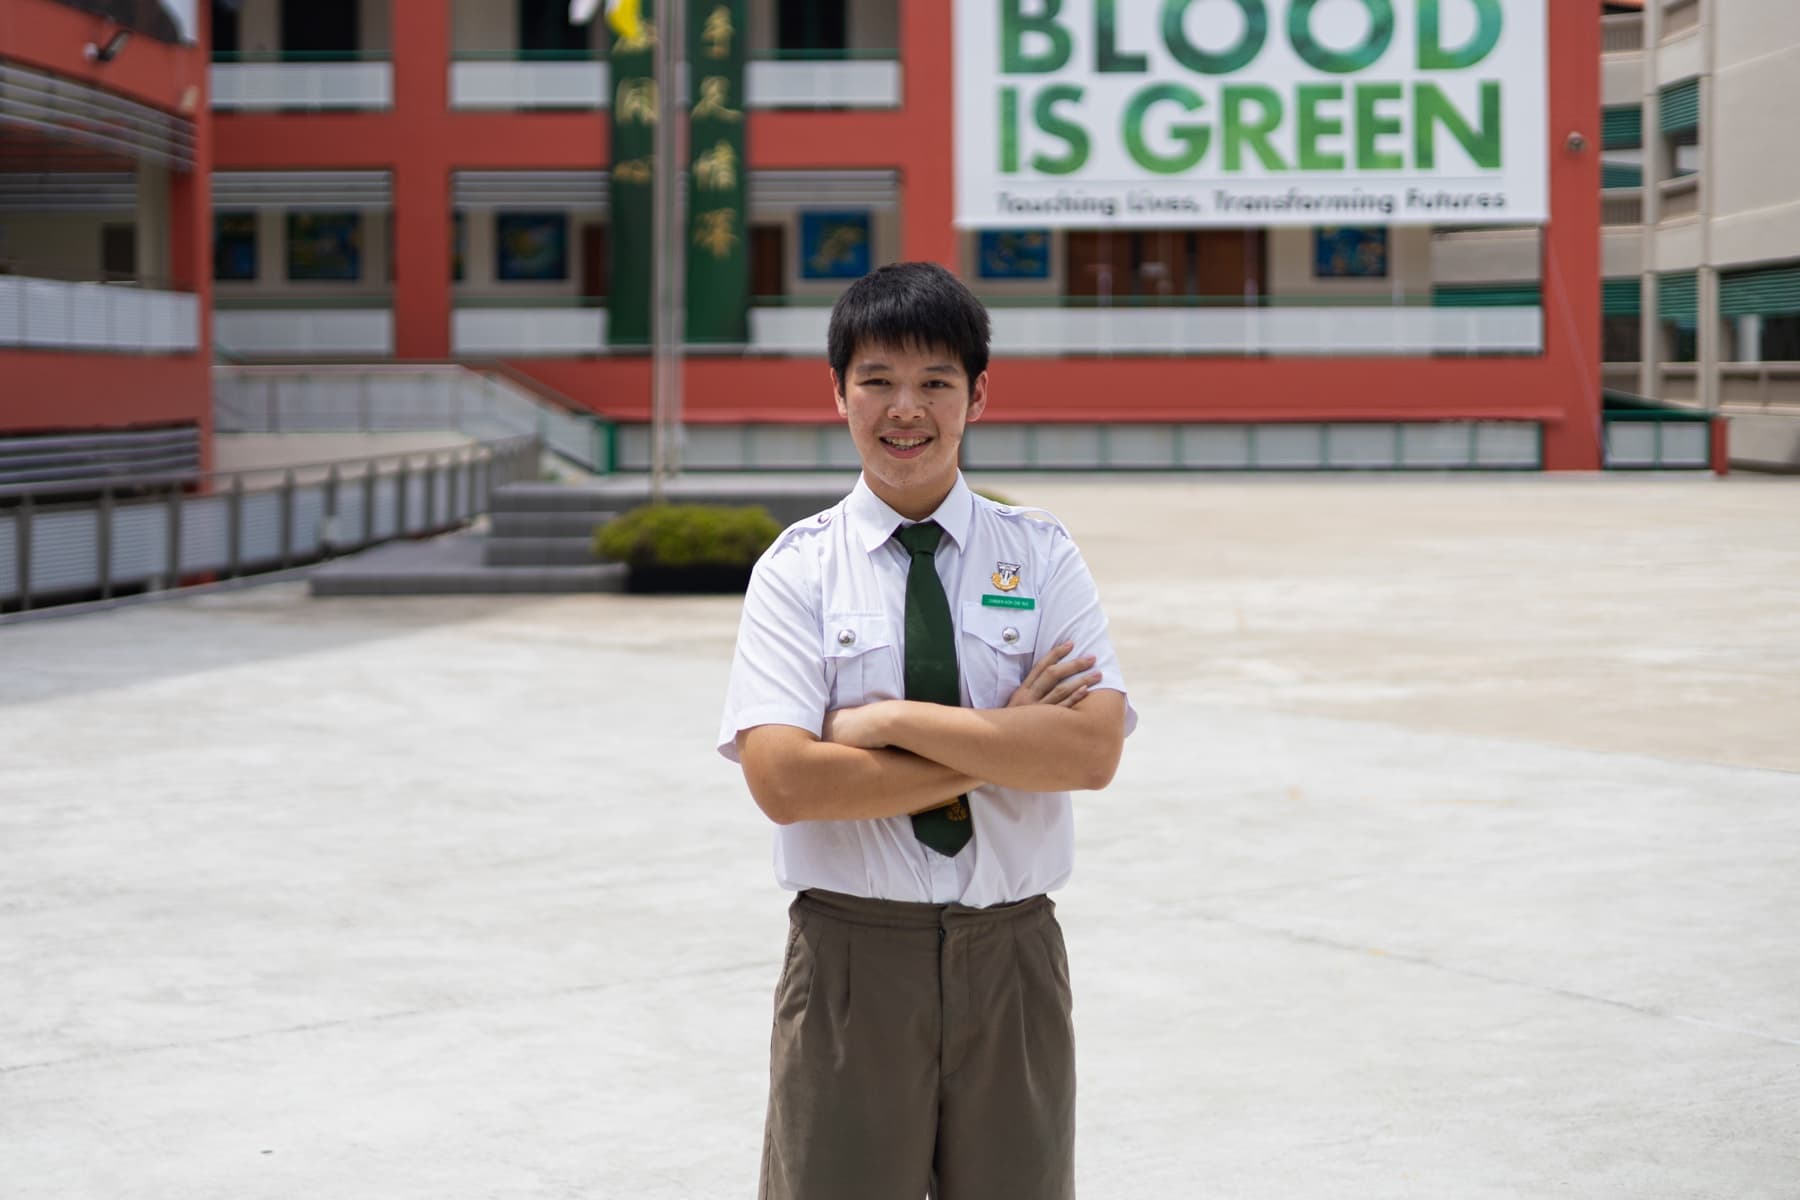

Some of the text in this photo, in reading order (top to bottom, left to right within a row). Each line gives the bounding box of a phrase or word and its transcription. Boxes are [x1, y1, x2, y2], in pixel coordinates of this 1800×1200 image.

[997, 0, 1503, 75] BLOOD
[998, 81, 1502, 176] IS GREEN
[997, 189, 1117, 217] Touching
[1212, 187, 1397, 215] Transforming
[1405, 187, 1508, 208] Futures
